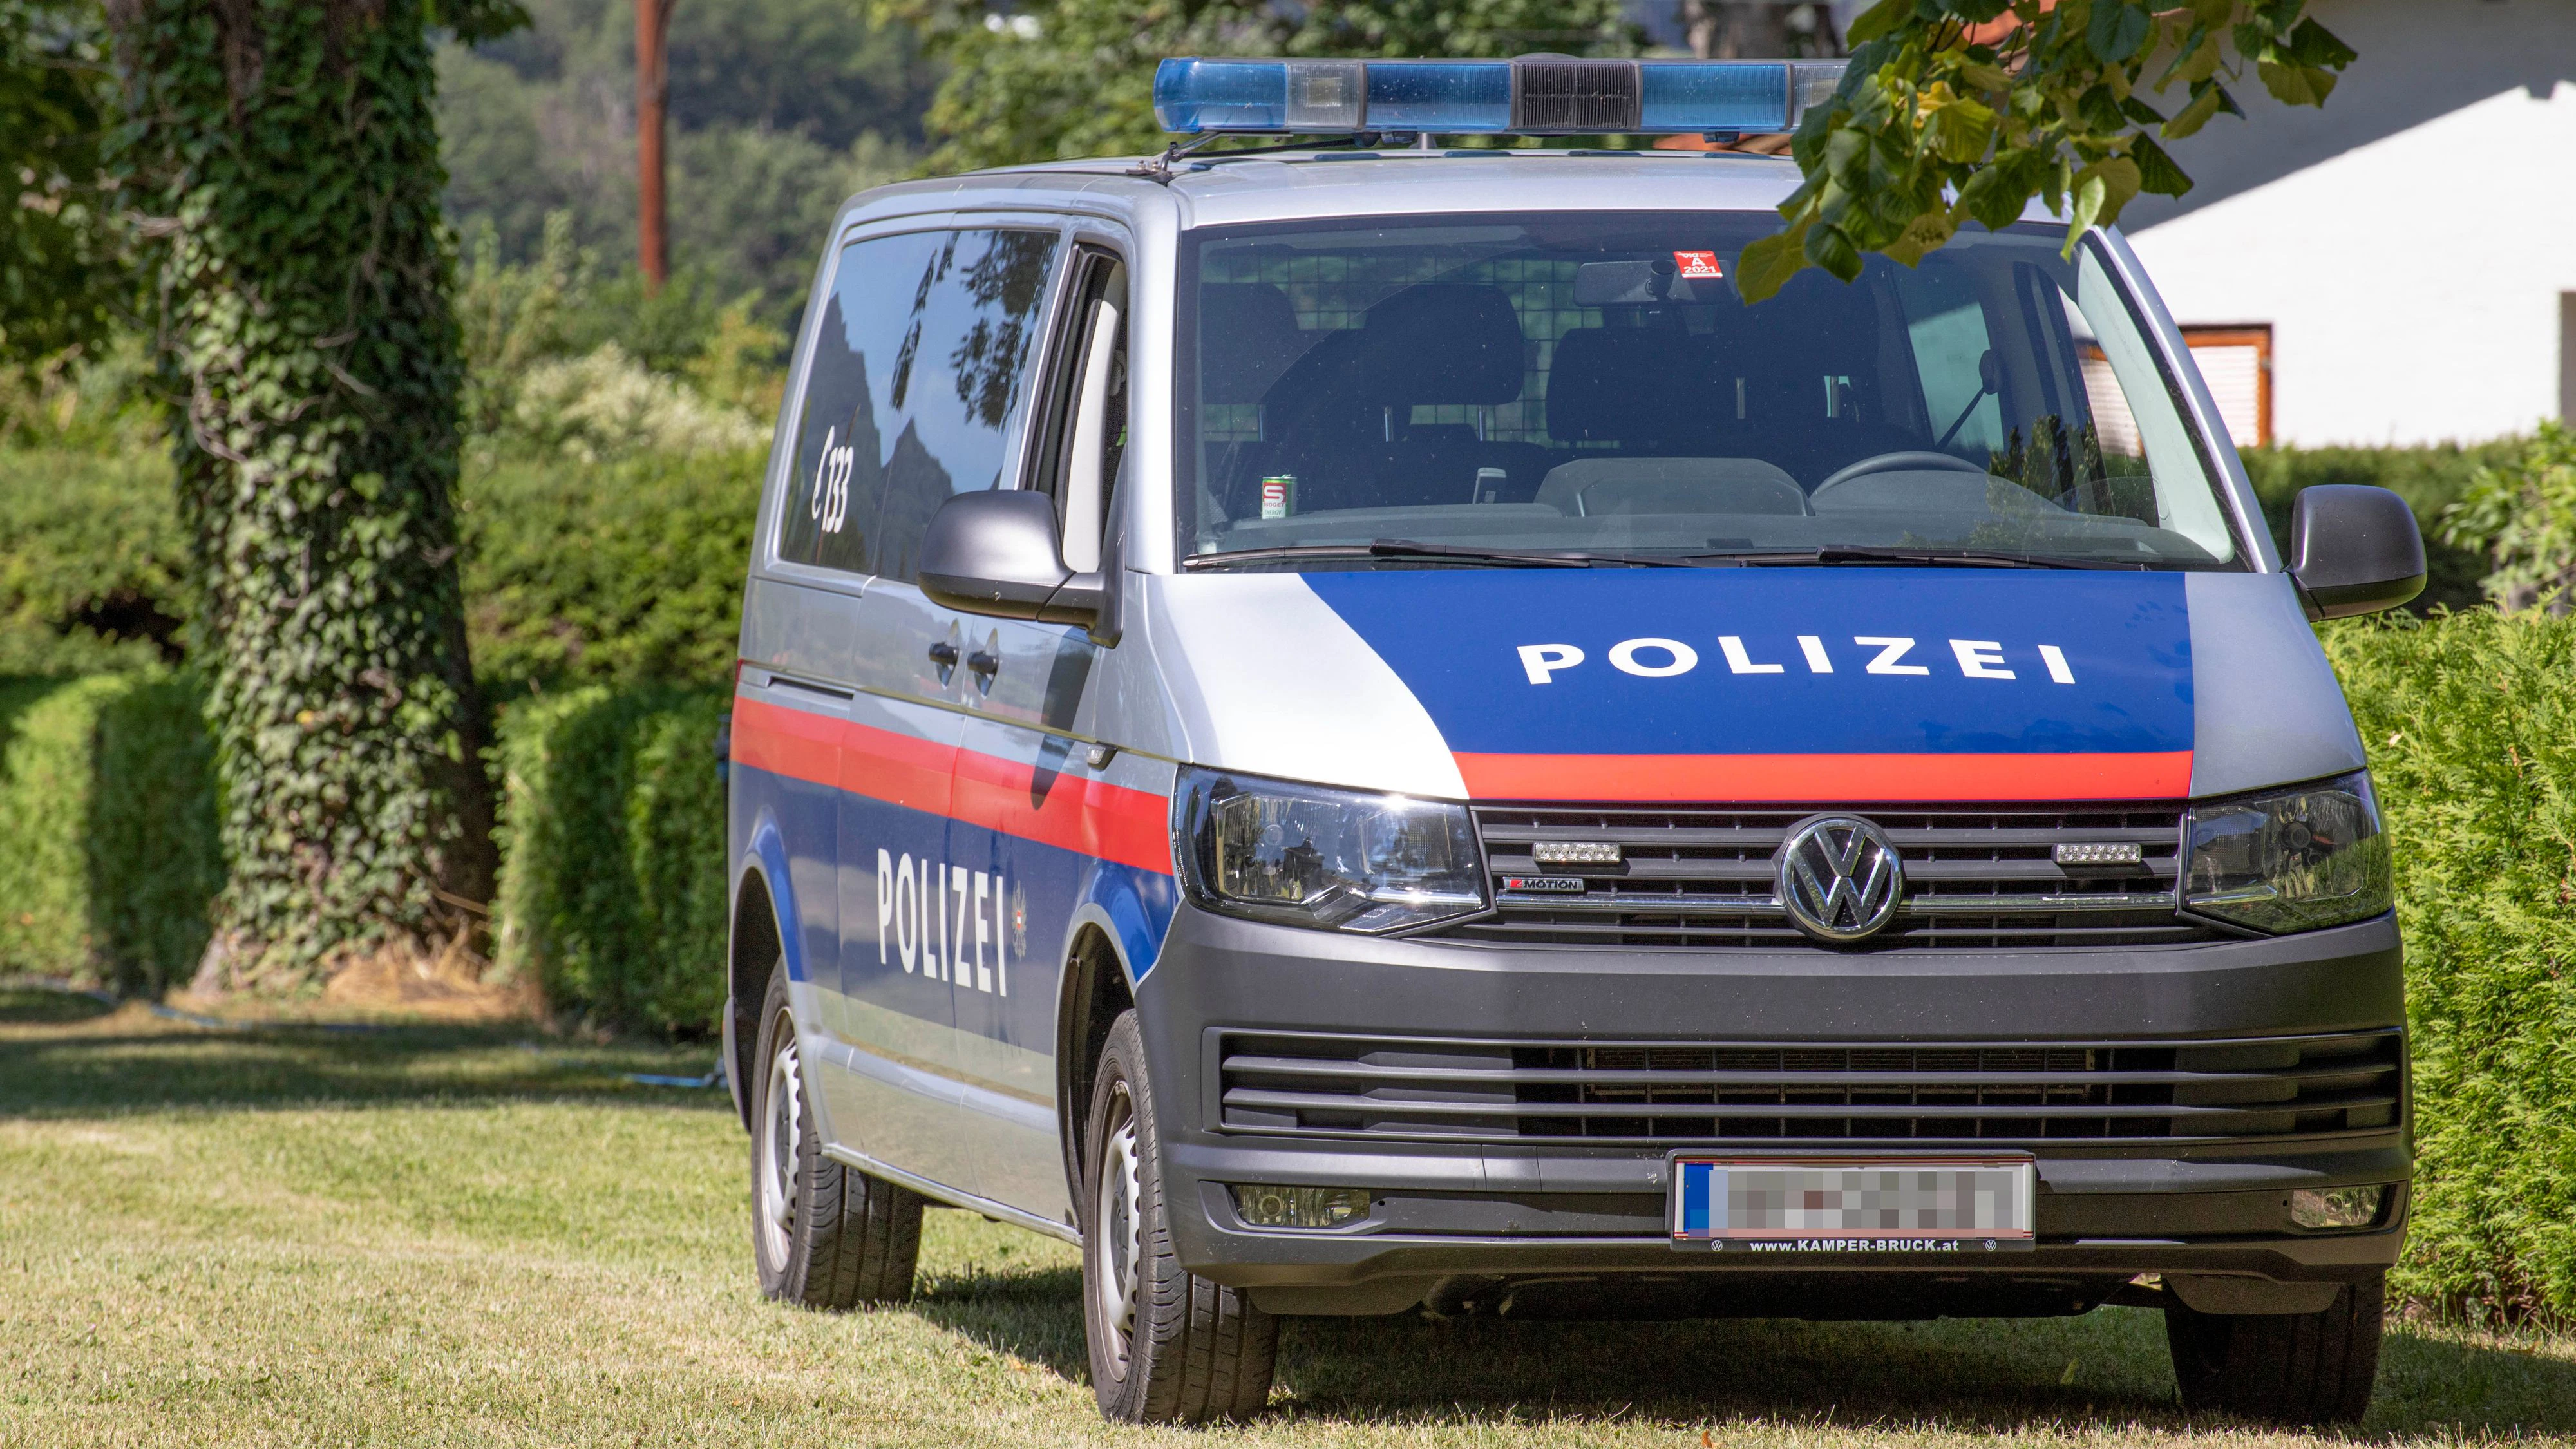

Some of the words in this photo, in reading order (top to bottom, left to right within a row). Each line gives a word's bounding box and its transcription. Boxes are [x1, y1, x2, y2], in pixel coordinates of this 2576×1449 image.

[822, 446, 854, 534] 133
[1517, 635, 2076, 685] POLIZEI
[878, 848, 1006, 998] POLIZEI
[1750, 1240, 1959, 1252] www.KAMPER-BRUCK.at
